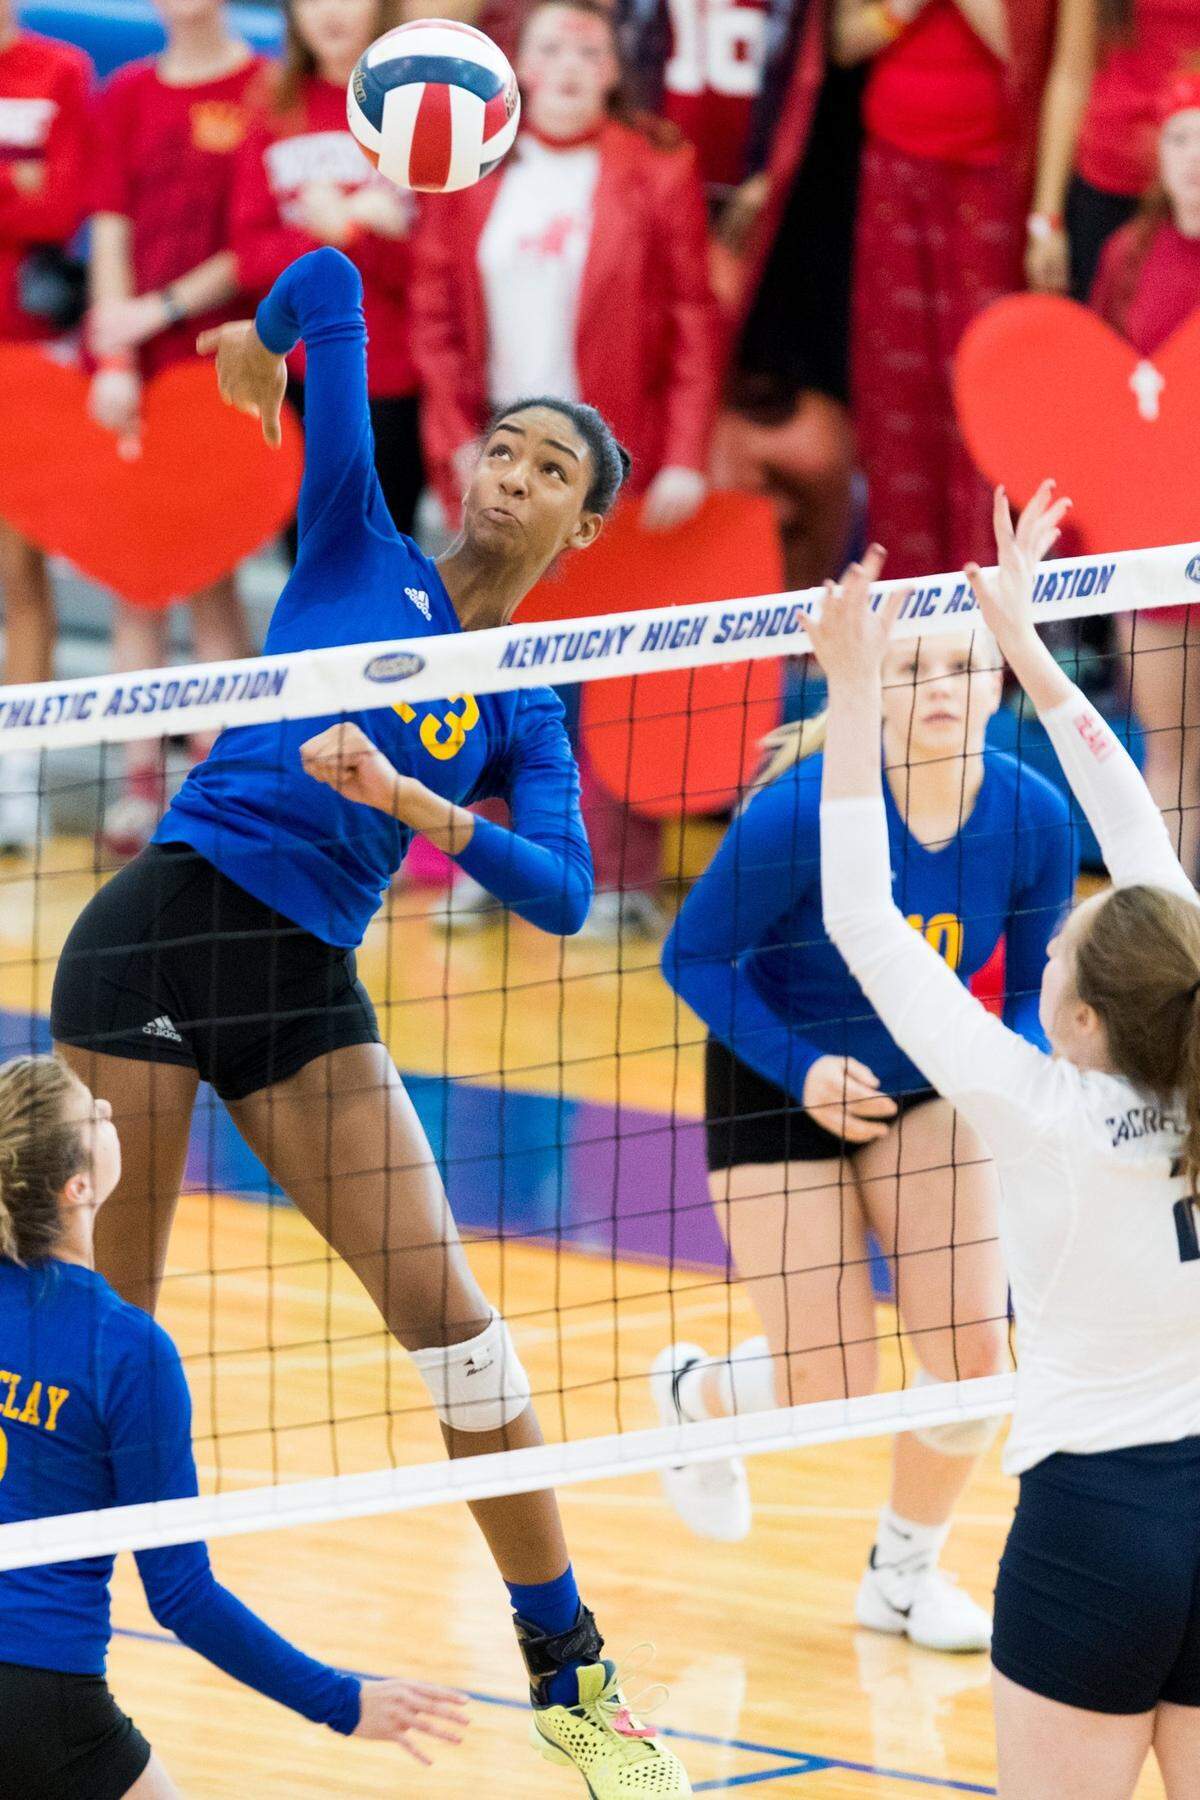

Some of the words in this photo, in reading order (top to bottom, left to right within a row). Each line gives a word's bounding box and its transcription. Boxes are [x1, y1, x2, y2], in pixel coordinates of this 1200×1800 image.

[497, 624, 637, 669] KENTUCKY
[640, 616, 708, 652] HIGH
[102, 667, 289, 718] ASSOCIATION
